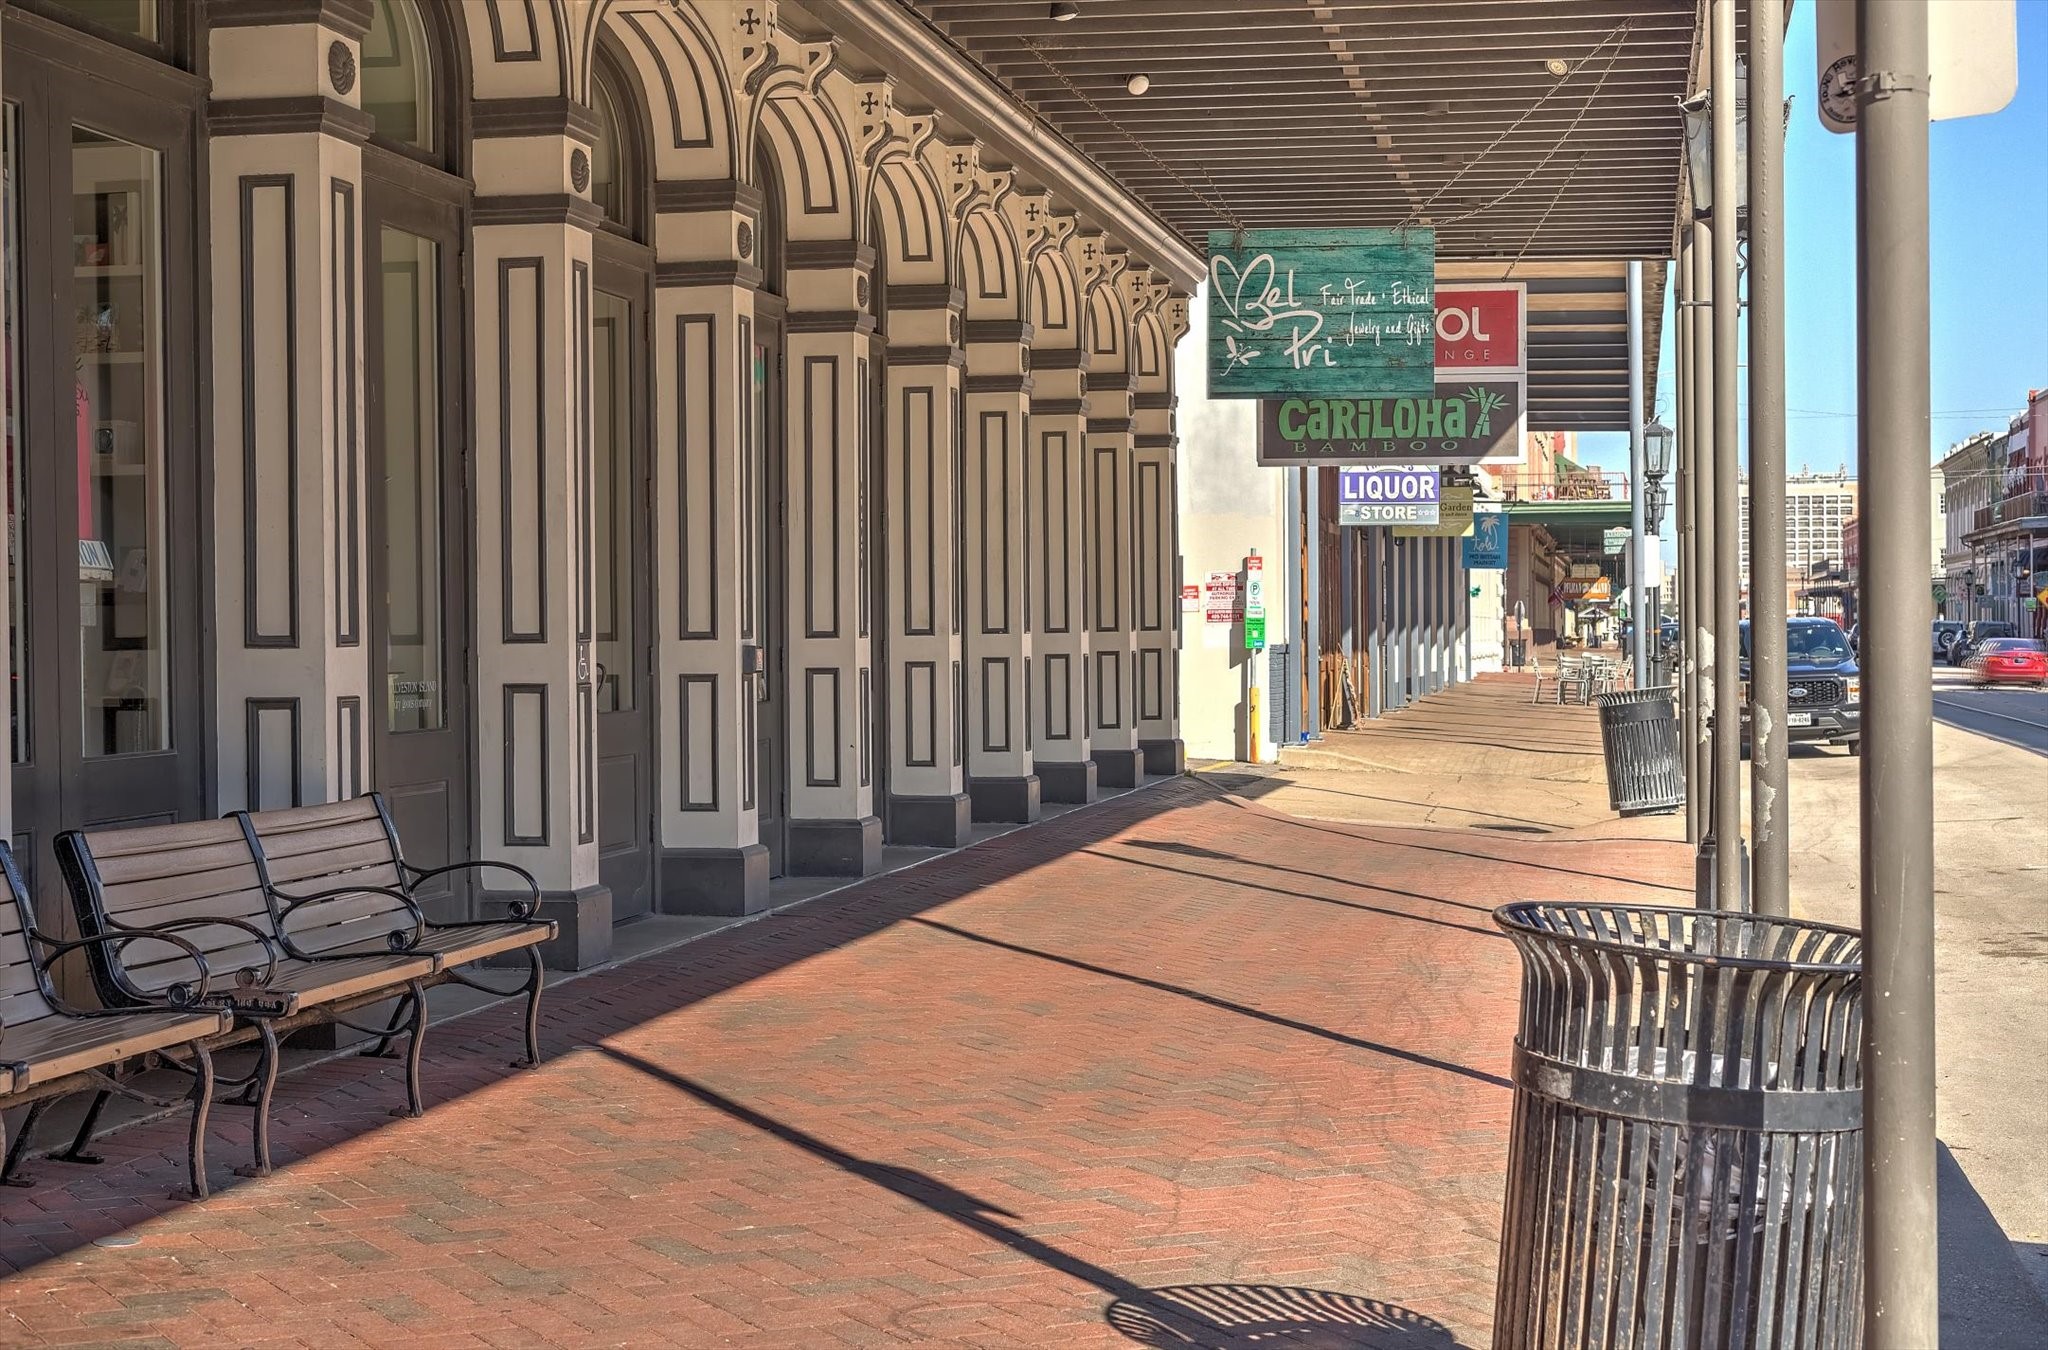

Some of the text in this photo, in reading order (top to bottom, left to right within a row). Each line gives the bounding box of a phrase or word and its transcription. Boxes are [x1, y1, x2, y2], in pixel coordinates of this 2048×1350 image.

[1320, 277, 1430, 306] Fair Trade Ethical
[1346, 311, 1430, 347] Jewelry and Gifts
[1294, 441, 1458, 453] BAMBOO
[1344, 475, 1436, 500] LIQUOR
[1360, 506, 1418, 520] STORE
[1440, 502, 1473, 512] Garden
